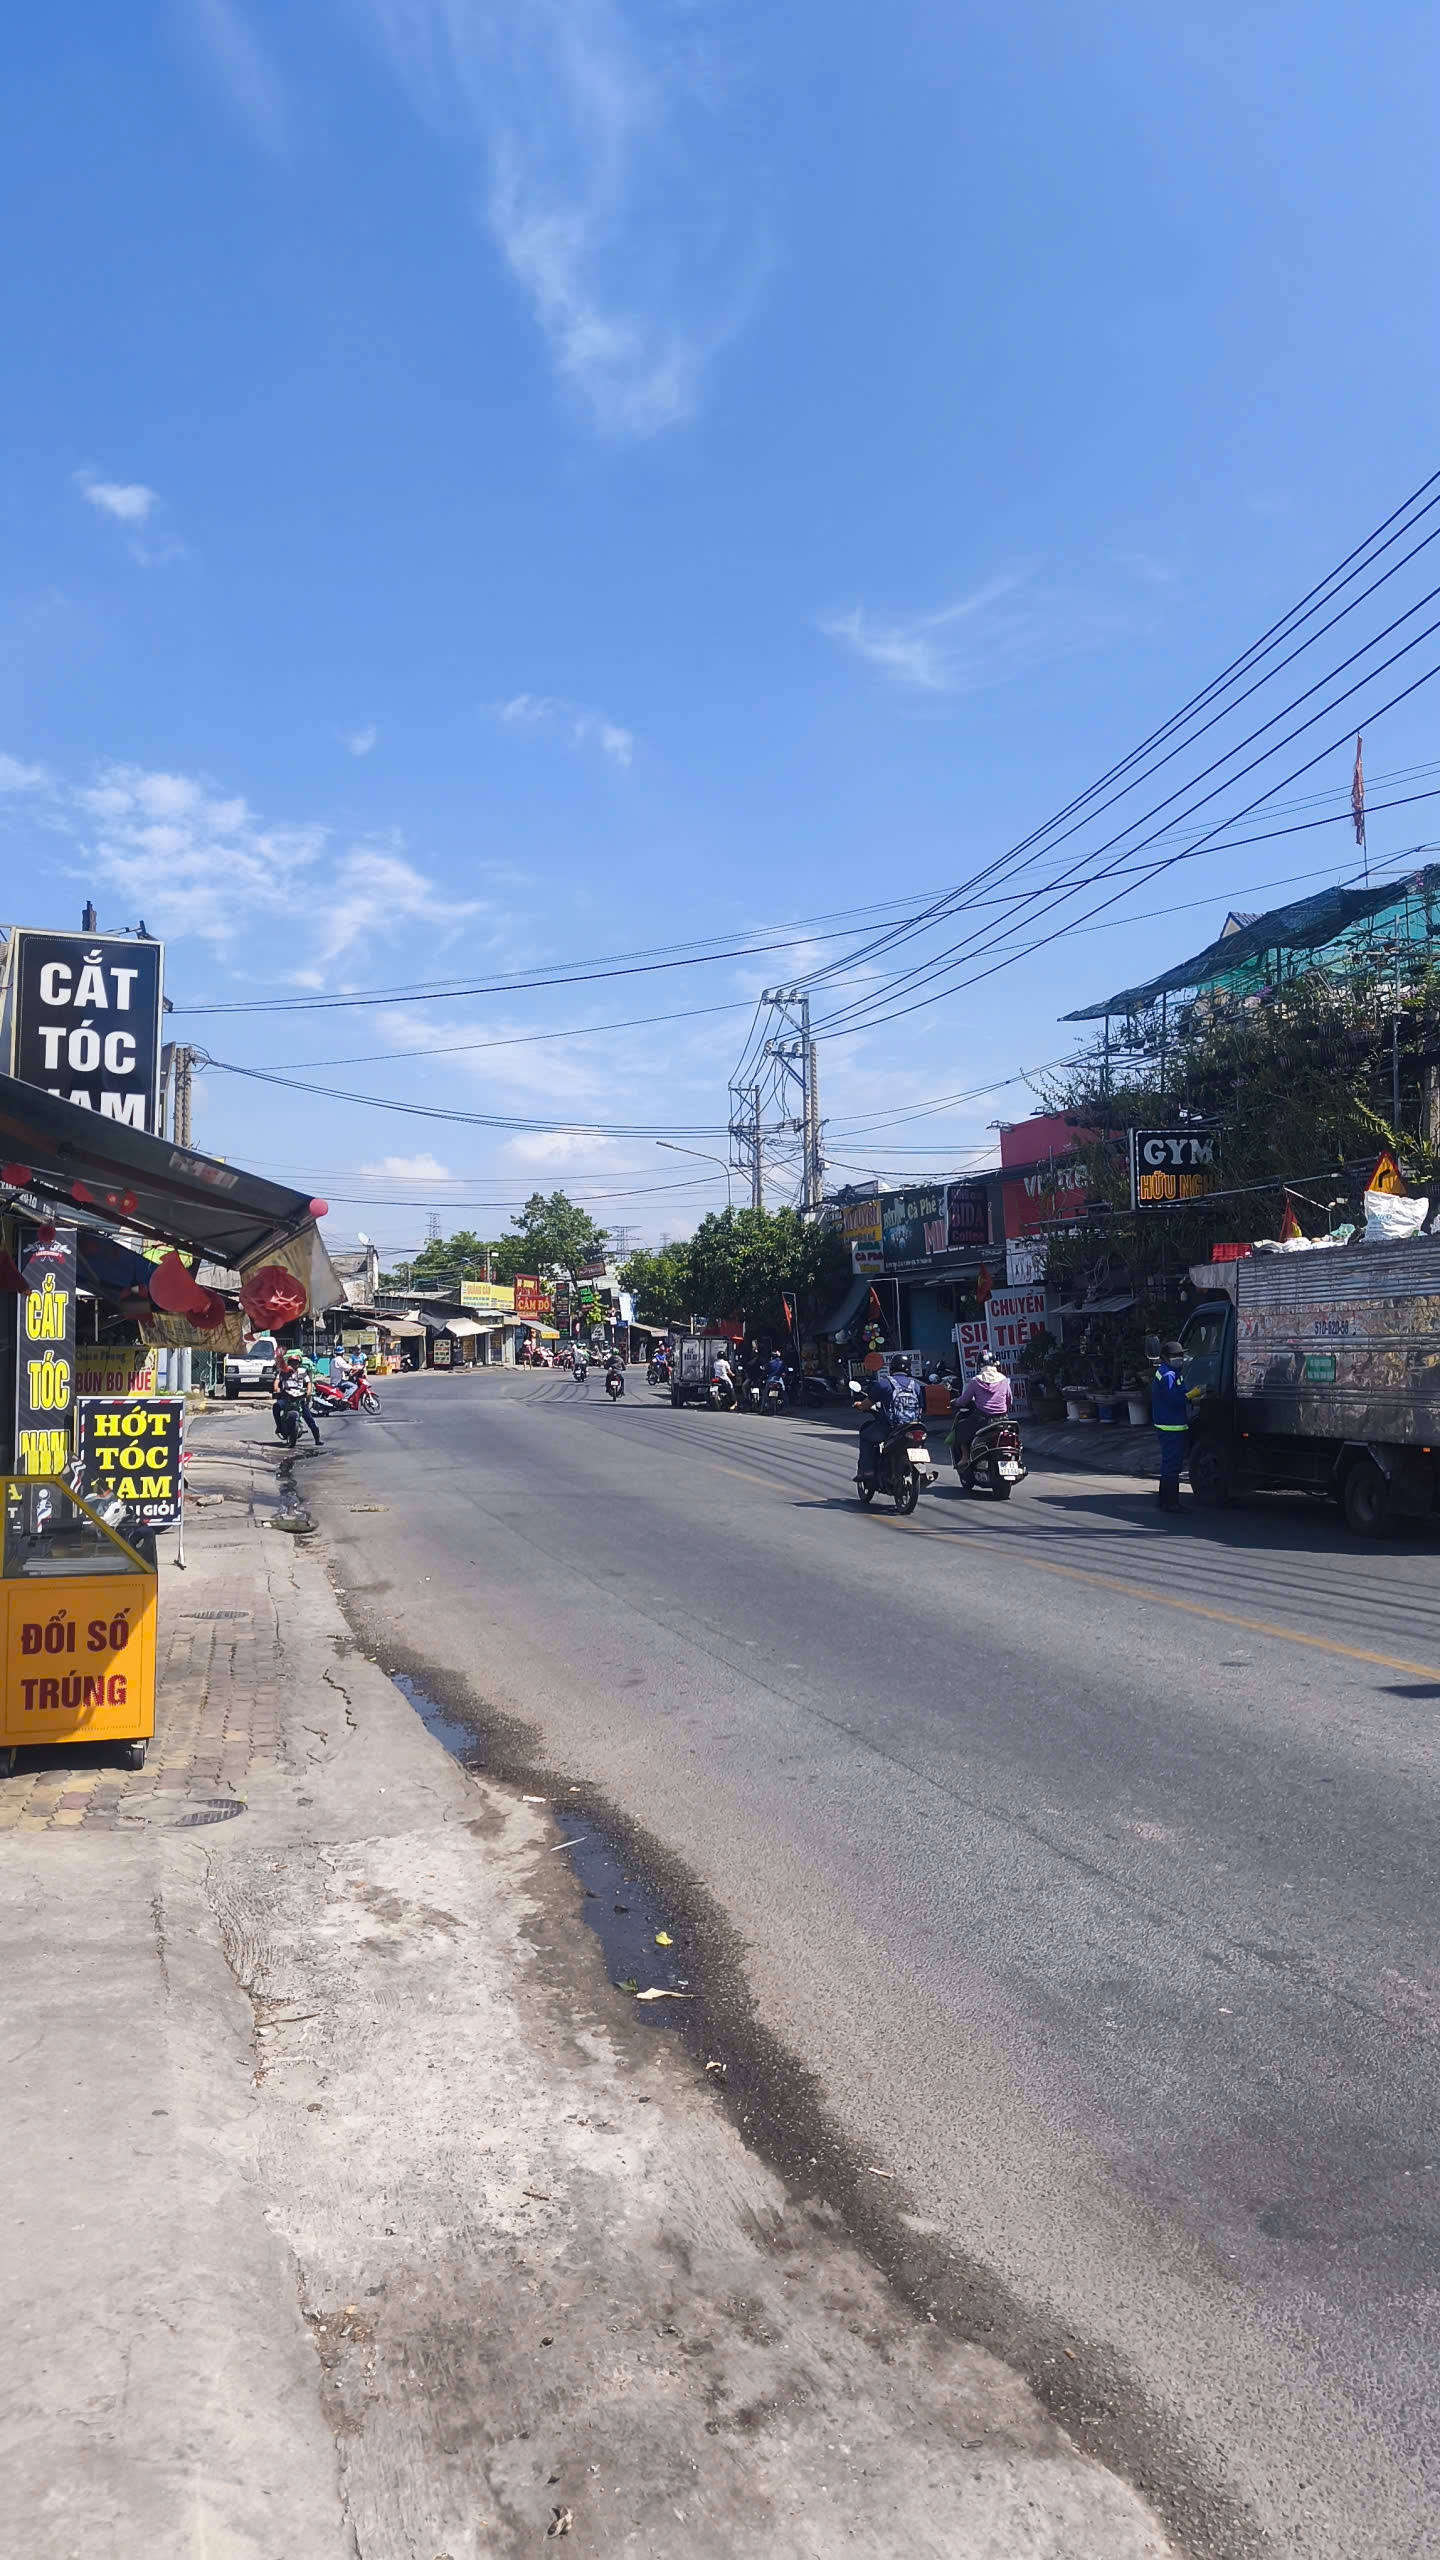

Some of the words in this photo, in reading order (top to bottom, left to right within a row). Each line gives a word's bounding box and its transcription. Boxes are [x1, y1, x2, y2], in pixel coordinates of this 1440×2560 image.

[39, 949, 138, 1011] CẮT
[38, 1019, 137, 1075] TÓC
[1143, 1138, 1215, 1165] GYM
[26, 1273, 69, 1340] CẮT
[990, 1289, 1045, 1317] CHUYỂN
[28, 1350, 70, 1410] TÓC
[75, 1368, 102, 1393] BÚN
[106, 1367, 124, 1392] BÒ
[93, 1405, 171, 1437] HỚT
[95, 1438, 169, 1470] TÓC
[20, 1608, 77, 1655] ĐỔI
[86, 1607, 131, 1652] SỐ
[20, 1669, 128, 1711] TRÚNG
